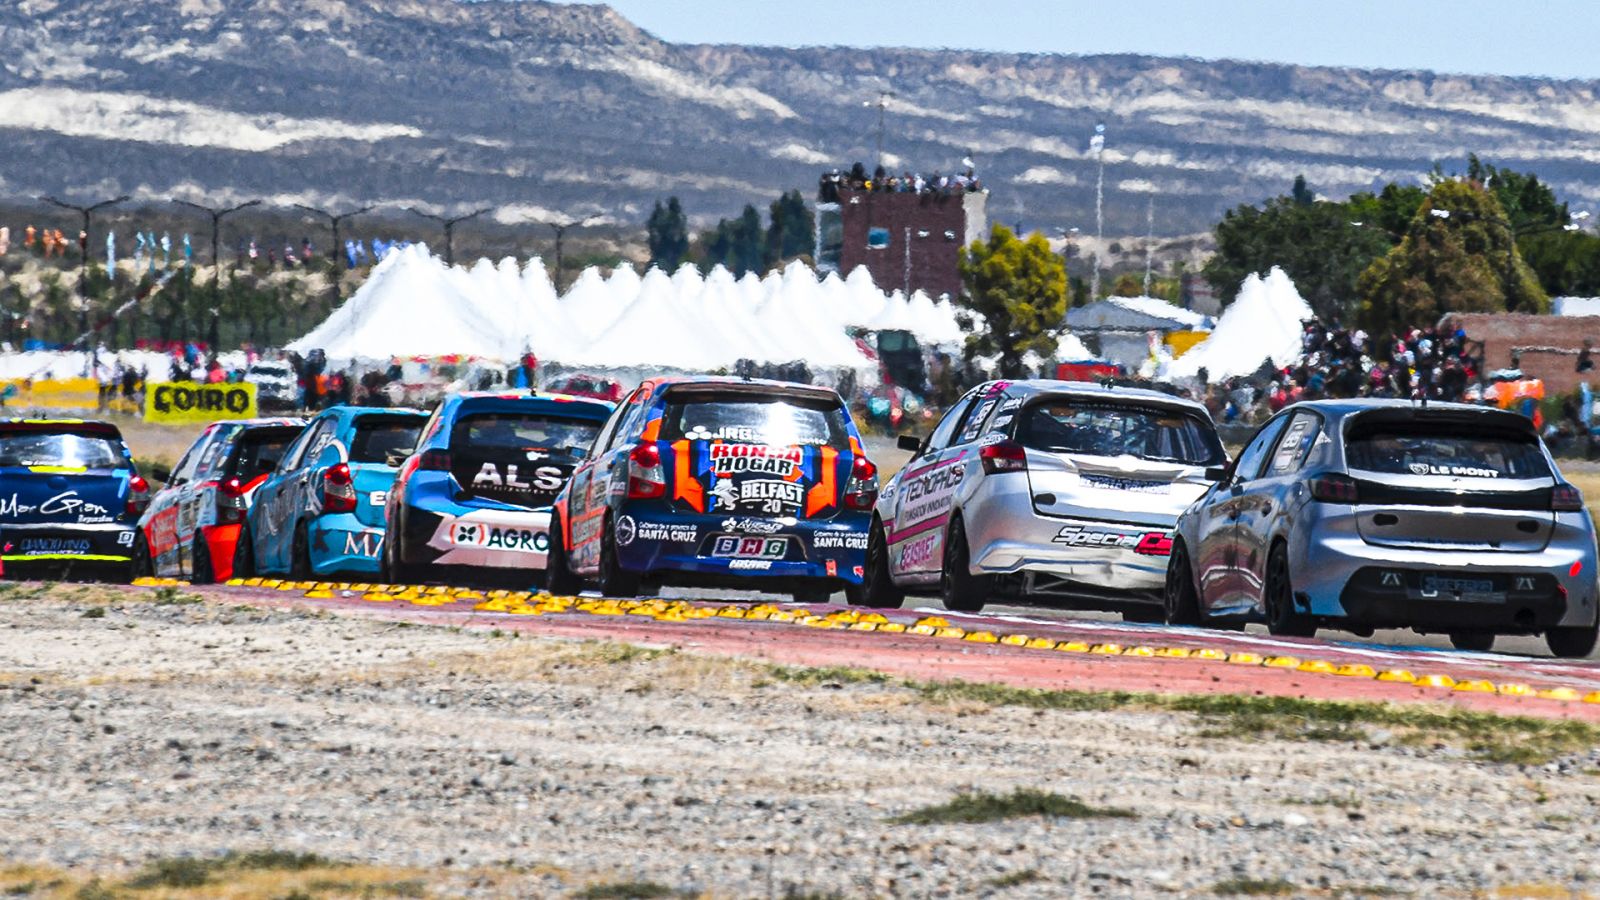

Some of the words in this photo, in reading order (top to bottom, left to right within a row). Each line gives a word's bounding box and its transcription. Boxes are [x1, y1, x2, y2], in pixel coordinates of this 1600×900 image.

[154, 386, 249, 414] COIRO
[718, 457, 791, 474] HOGAR
[1430, 466, 1450, 474] LE
[1452, 467, 1498, 478] MONT
[473, 462, 562, 490] ALS
[741, 482, 803, 503] BELFAST
[762, 499, 781, 513] 20
[487, 528, 550, 551] AGRO
[638, 529, 669, 540] SANTA
[671, 530, 697, 542] CRUZ
[813, 537, 844, 548] SANTA
[845, 538, 869, 549] CRUZ
